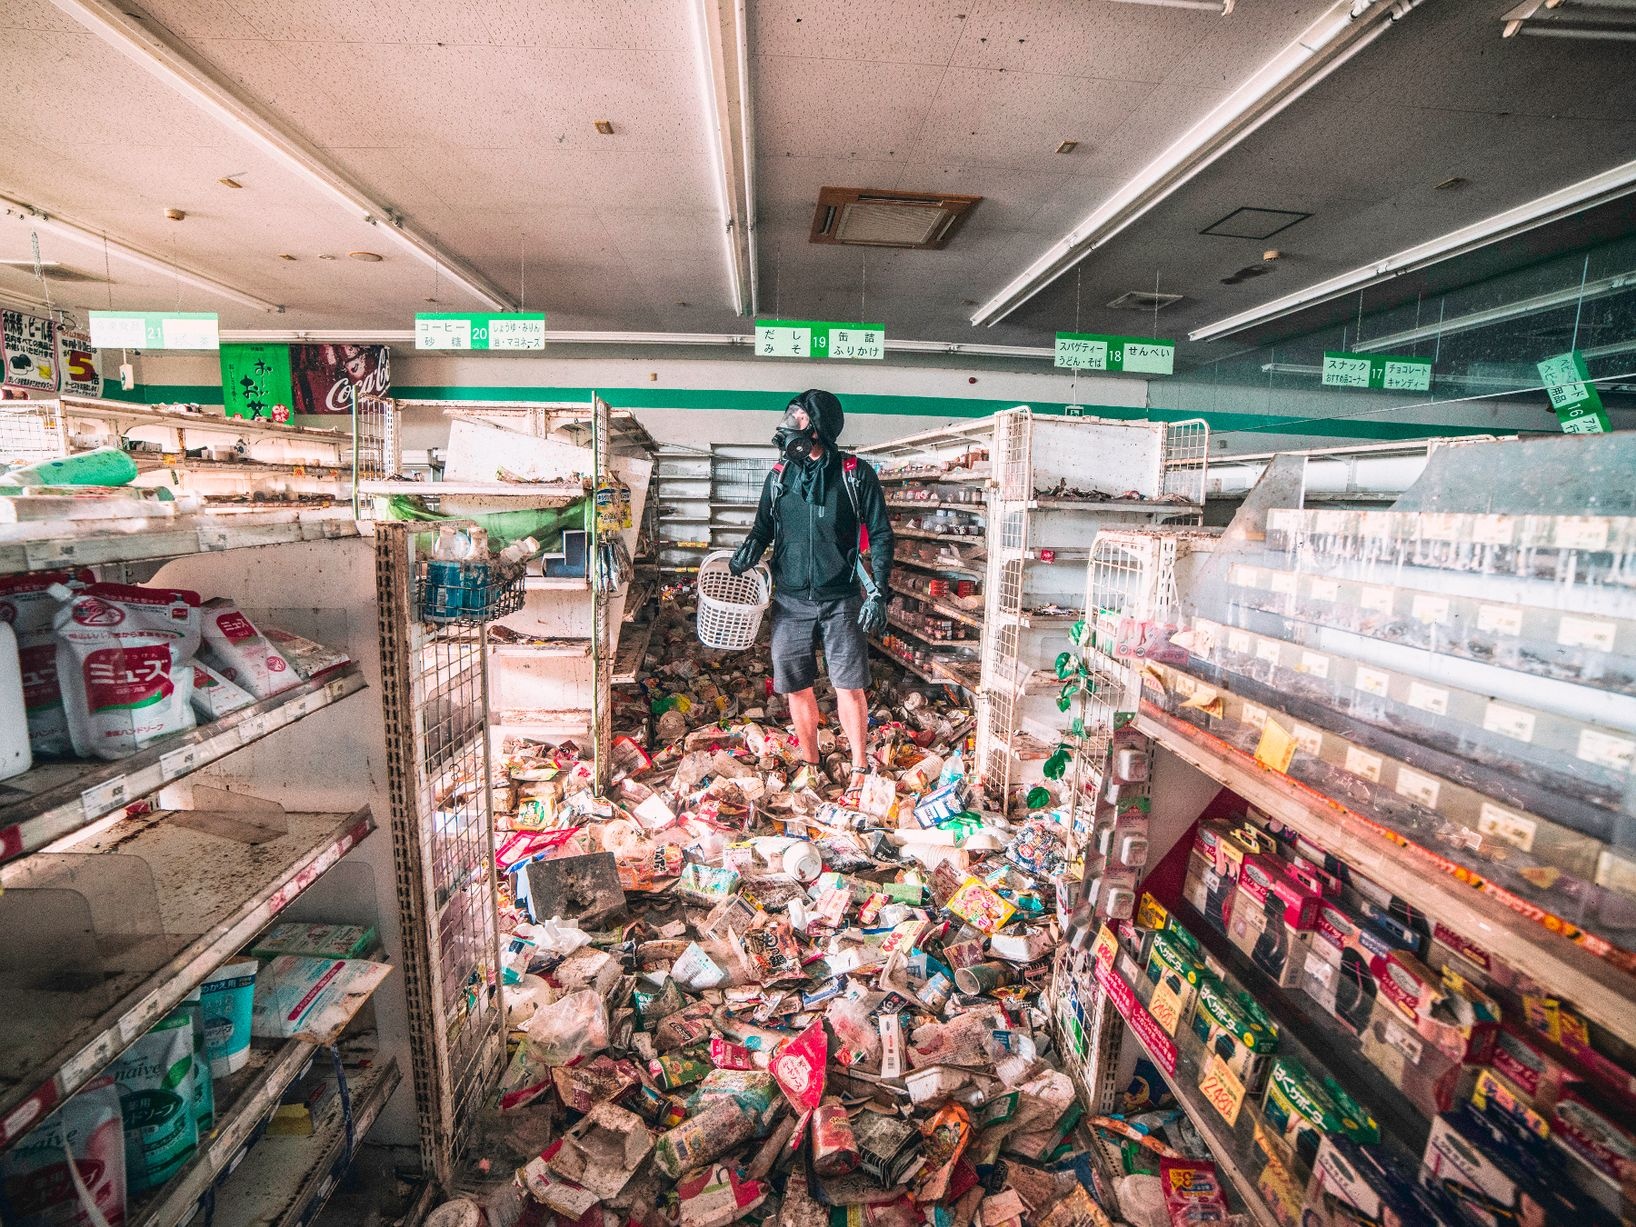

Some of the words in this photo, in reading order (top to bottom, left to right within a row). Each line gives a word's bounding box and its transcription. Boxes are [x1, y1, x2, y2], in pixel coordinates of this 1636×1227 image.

[147, 327, 161, 339] 21
[420, 323, 465, 332] コーヒー
[472, 328, 488, 340] 20
[838, 331, 875, 343] 缶詰
[813, 336, 826, 348] 19
[1059, 342, 1103, 353] スパゲティー
[834, 346, 879, 357] ふりかけ
[1109, 350, 1121, 362] 18
[1129, 346, 1169, 357] せんべい
[69, 349, 95, 381] 5
[1059, 356, 1103, 367] うどん・そば
[1329, 360, 1366, 370] スナック
[1371, 368, 1383, 379] 17
[1389, 364, 1427, 375] チョコレート
[1388, 378, 1425, 388] キャンディー
[1568, 403, 1583, 417] 16
[90, 659, 169, 684] ミューズ
[1273, 1062, 1328, 1131] はくサポーター
